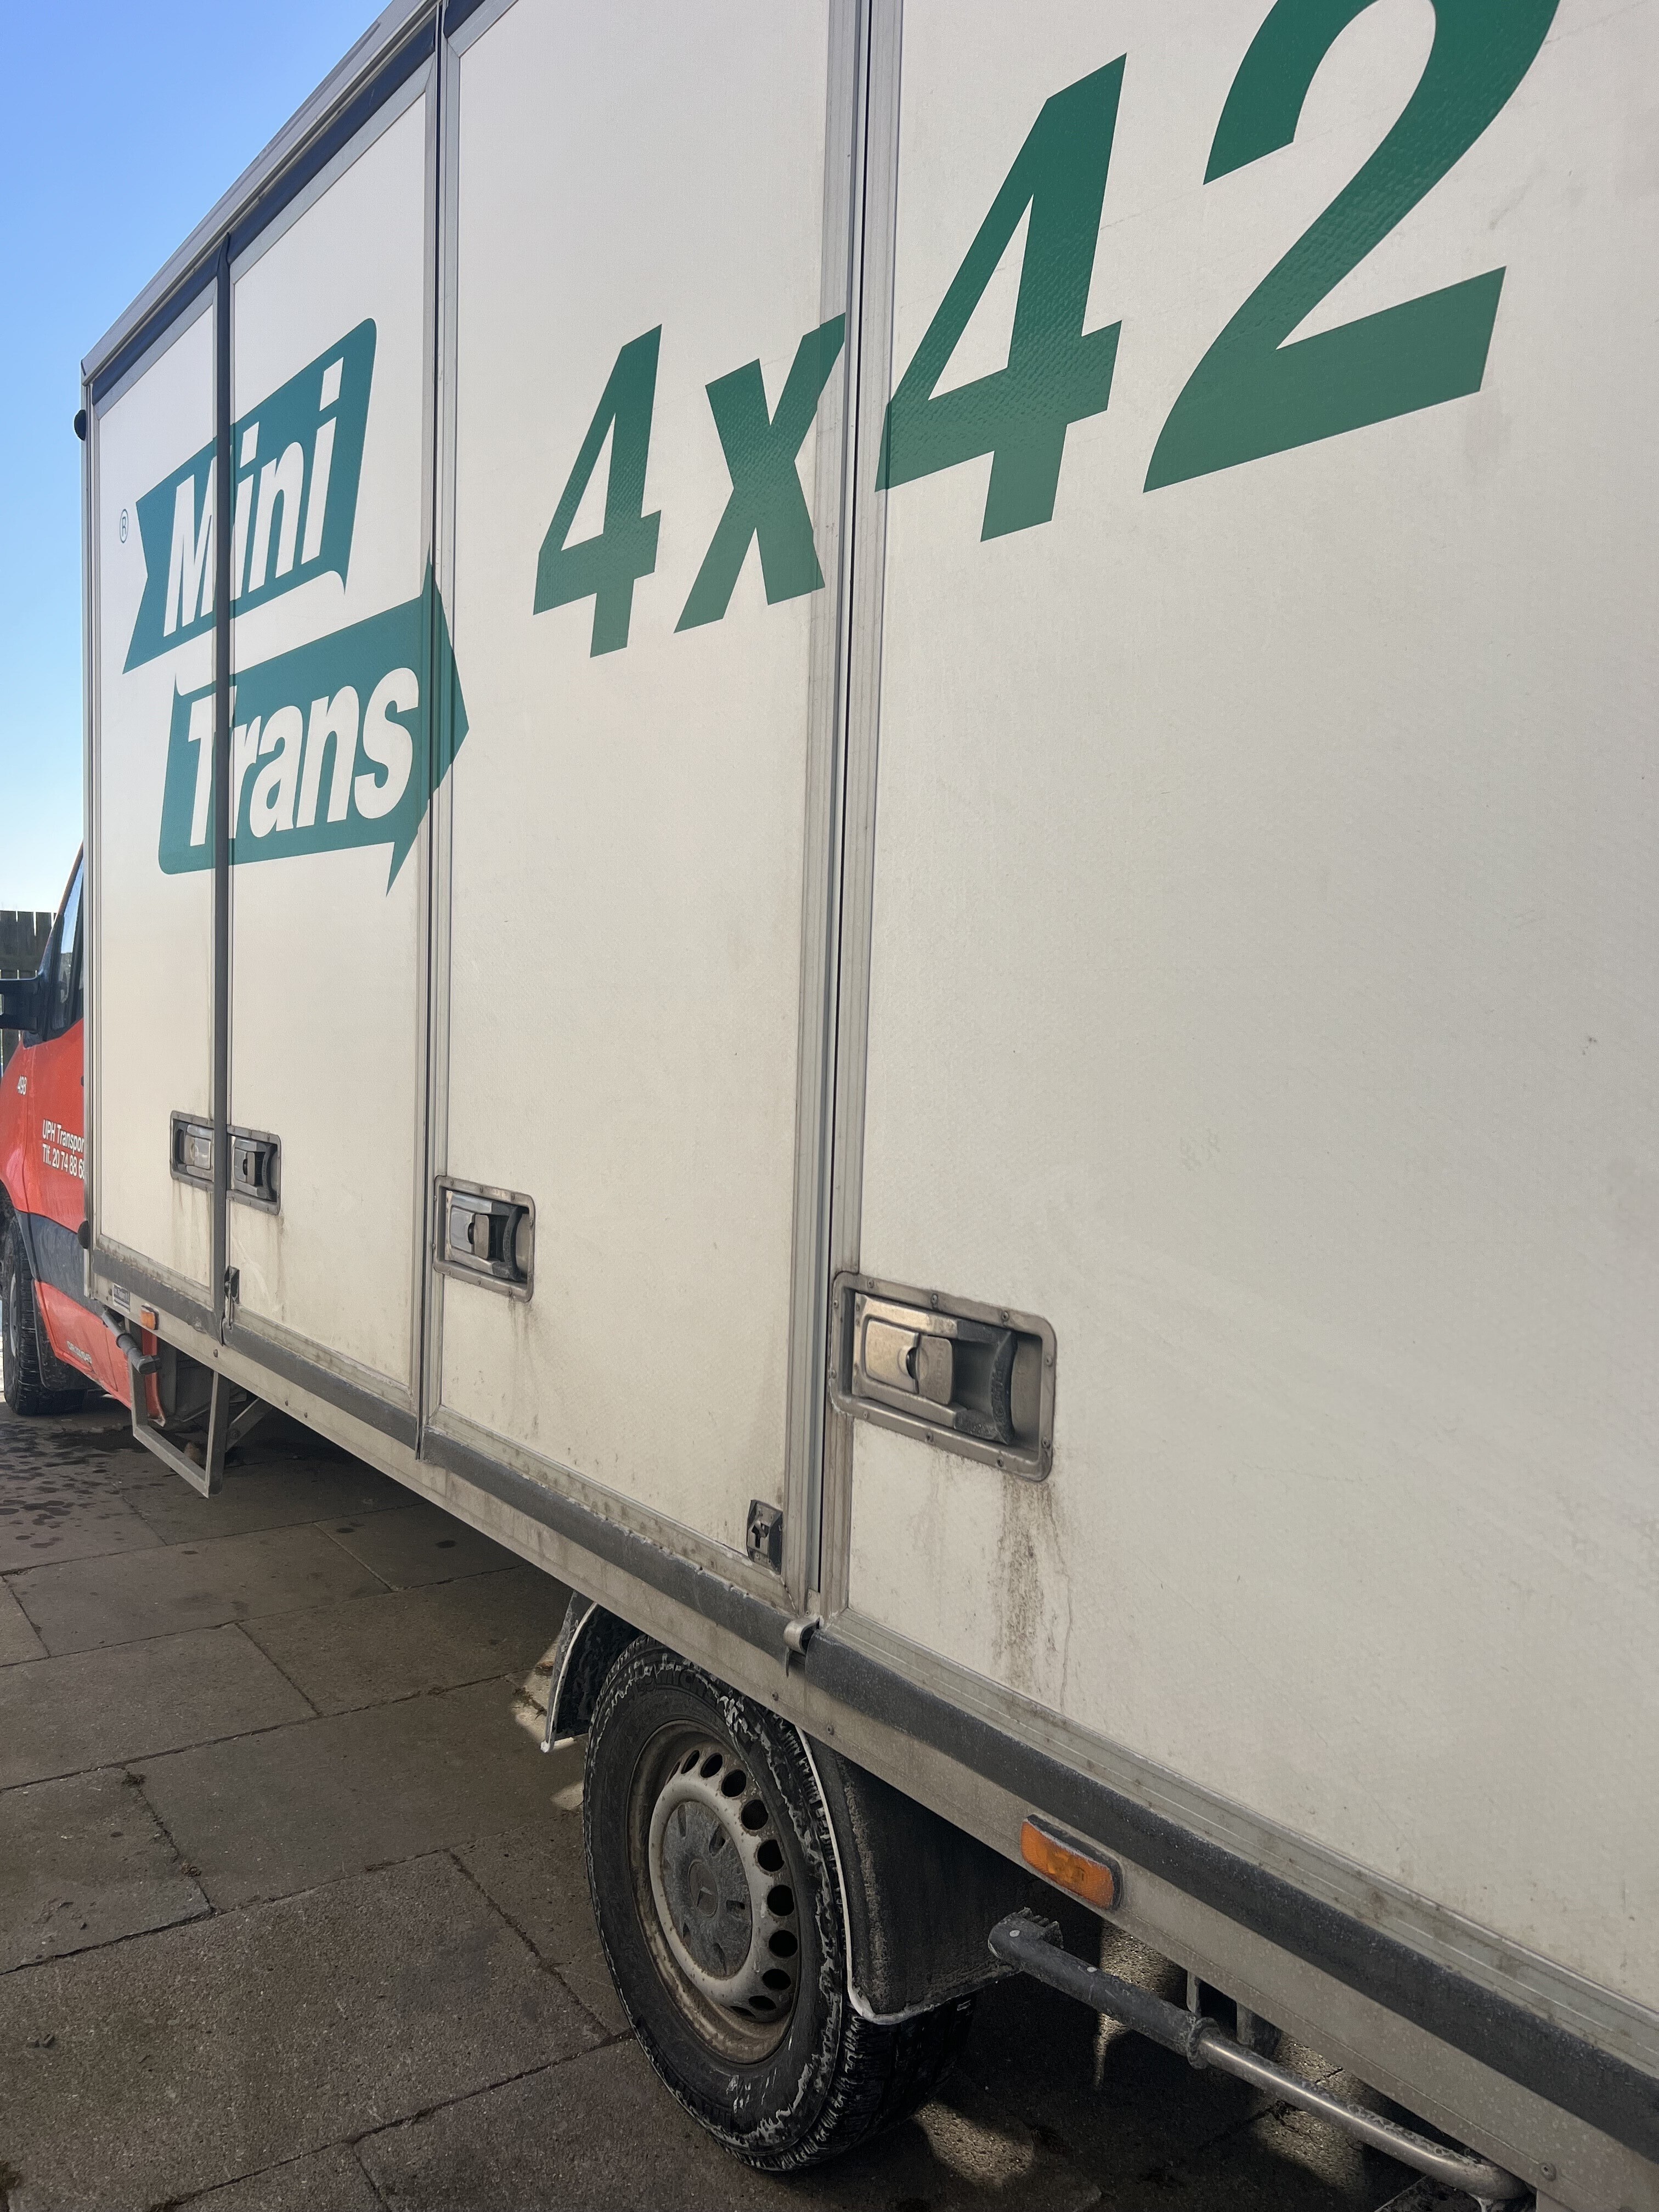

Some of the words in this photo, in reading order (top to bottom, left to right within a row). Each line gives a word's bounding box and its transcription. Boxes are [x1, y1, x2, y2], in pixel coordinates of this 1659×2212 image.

[163, 357, 344, 637] Mini
[188, 668, 419, 847] Trans
[43, 1119, 55, 1142] UPH
[57, 1124, 84, 1154] Transpor
[43, 1143, 51, 1165] Tlf.
[52, 1148, 60, 1169] 20
[61, 1151, 68, 1172] 74
[69, 1155, 77, 1176] 88
